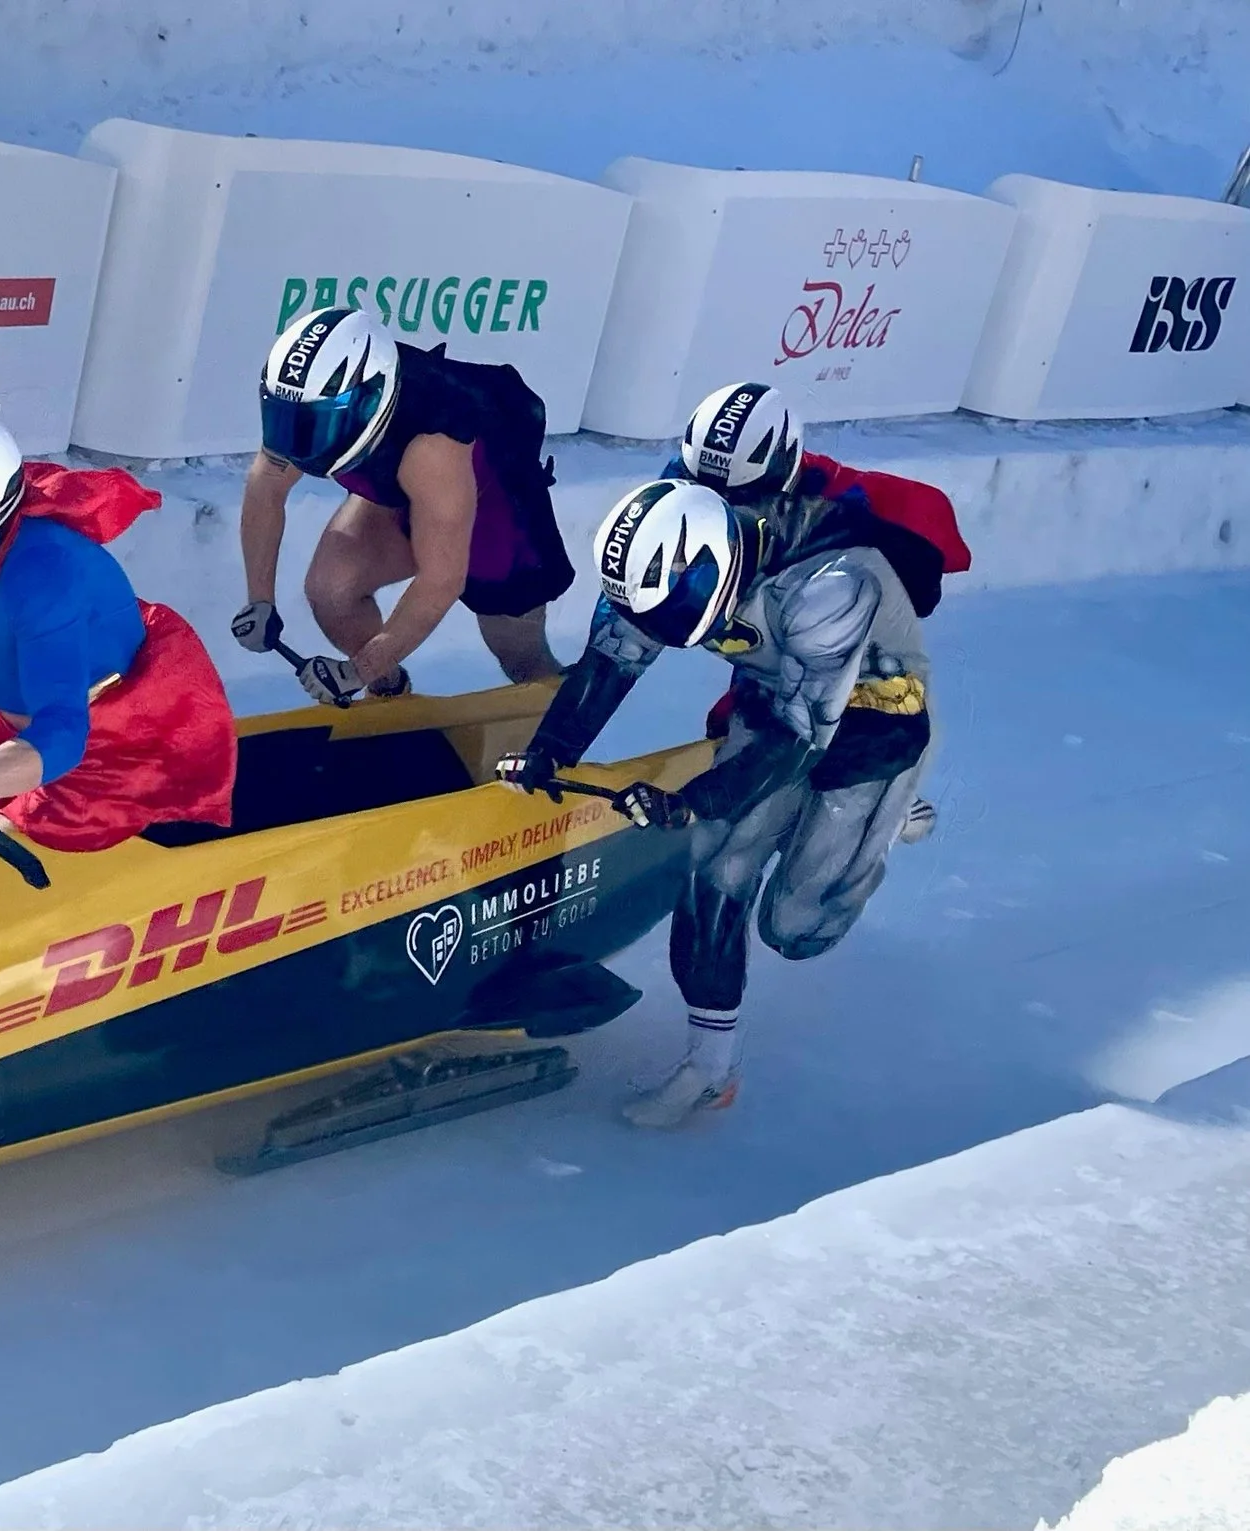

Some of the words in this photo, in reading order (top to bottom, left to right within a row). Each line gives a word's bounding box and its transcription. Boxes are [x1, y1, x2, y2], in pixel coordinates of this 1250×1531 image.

[275, 275, 549, 335] PASSUGGER
[773, 276, 903, 367] Delea
[286, 322, 328, 382] xDrive
[275, 385, 305, 403] BMW
[713, 391, 754, 448] xDrive
[700, 450, 733, 468] BMW
[606, 500, 644, 574] xDrive
[460, 832, 518, 874] SIMPLY
[470, 857, 601, 926] IMMOLIEBE
[41, 876, 286, 1018] DHL
[470, 926, 524, 965] BETON
[531, 916, 550, 940] ZU
